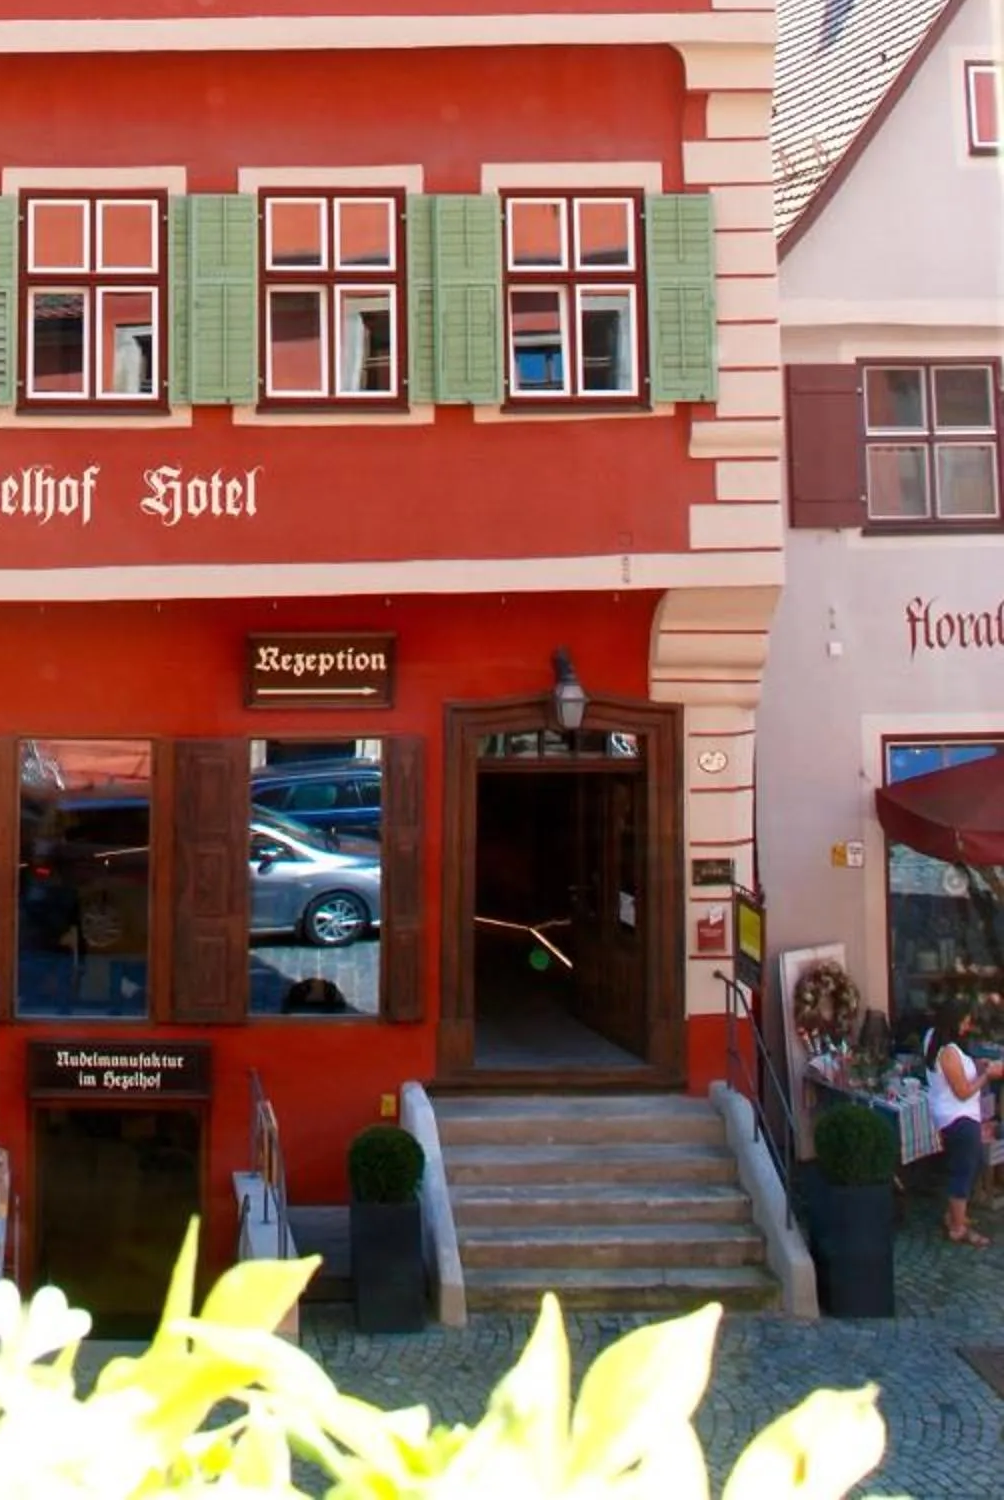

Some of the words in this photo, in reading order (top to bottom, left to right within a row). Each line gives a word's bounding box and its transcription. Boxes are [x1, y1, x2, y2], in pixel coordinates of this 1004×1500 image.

[140, 465, 265, 528] Hotel
[254, 646, 387, 677] Rezeption
[56, 1051, 184, 1069] Nudelmanufaktur
[79, 1070, 96, 1087] im
[103, 1071, 161, 1090] Hezelhof
